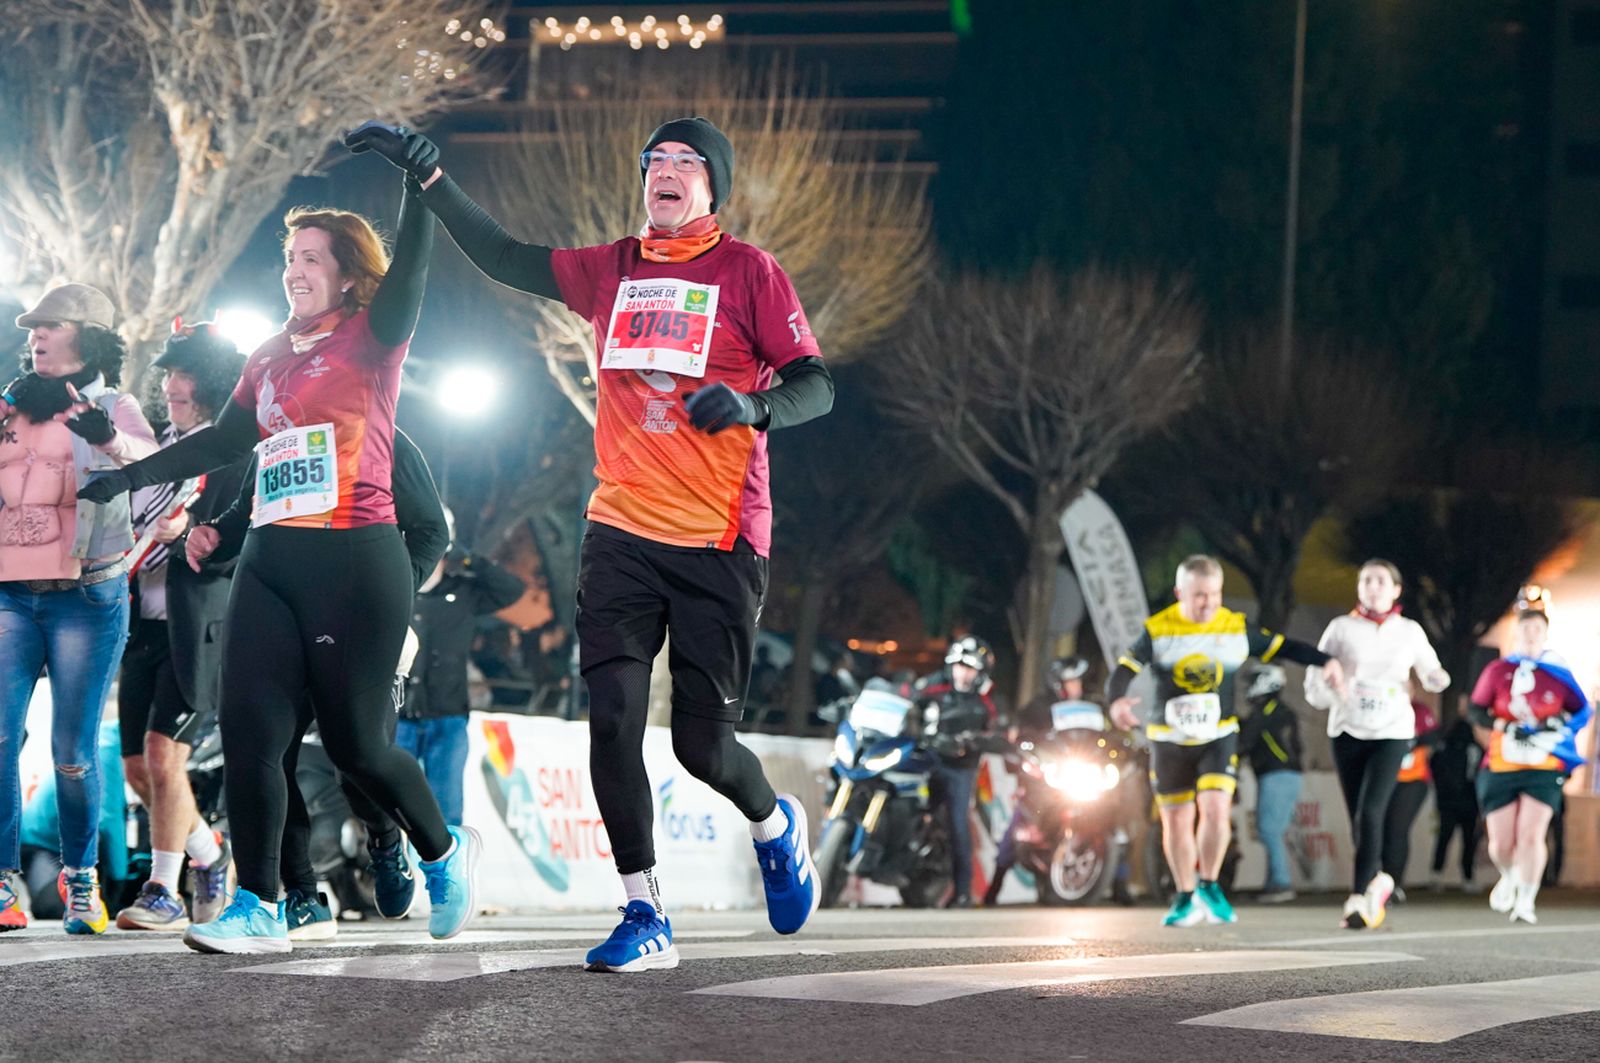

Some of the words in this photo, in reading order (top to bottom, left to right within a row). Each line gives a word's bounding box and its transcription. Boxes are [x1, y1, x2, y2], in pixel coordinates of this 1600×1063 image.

[625, 301, 643, 310] SAN
[637, 289, 664, 298] NOCHE
[666, 288, 677, 298] DE
[628, 311, 689, 340] 9745
[263, 457, 325, 495] 13855
[538, 767, 582, 810] SAN
[551, 819, 612, 861] ANTO
